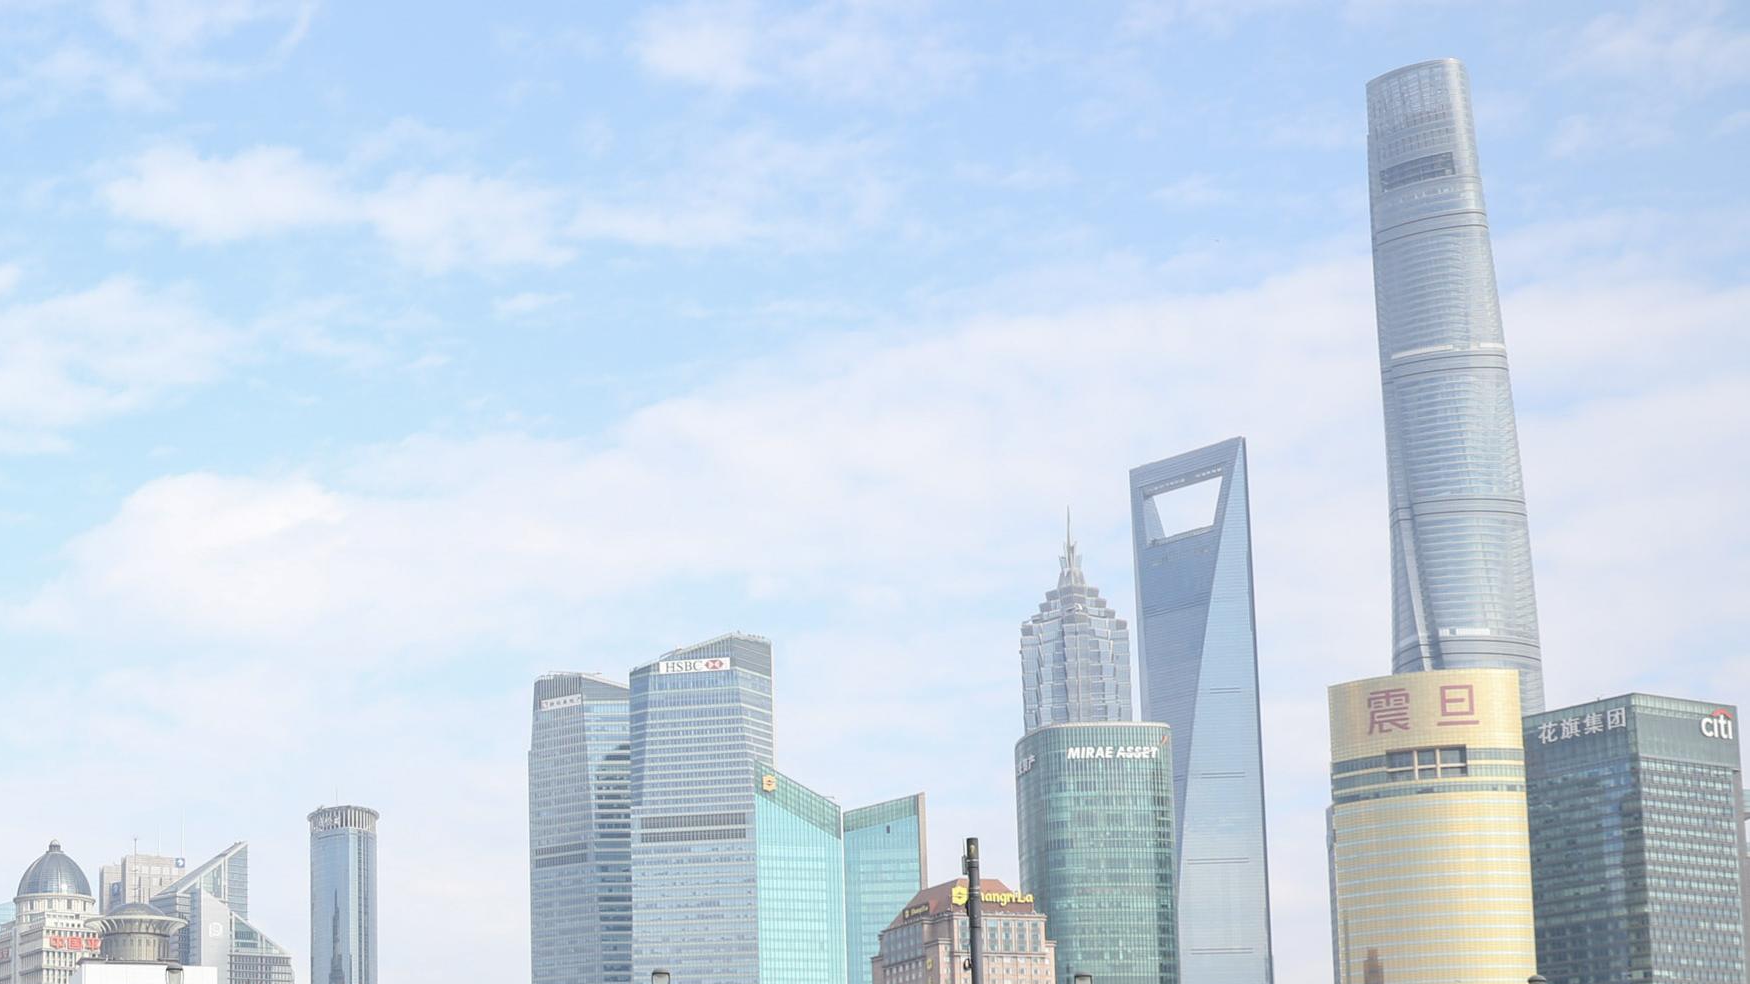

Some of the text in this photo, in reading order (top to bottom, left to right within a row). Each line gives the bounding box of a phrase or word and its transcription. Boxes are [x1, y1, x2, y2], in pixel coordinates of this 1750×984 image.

[665, 660, 703, 673] HSBC
[1367, 684, 1480, 735] 震旦
[1537, 706, 1626, 744] 花旗集团
[1067, 746, 1158, 759] MIRAE ASSET
